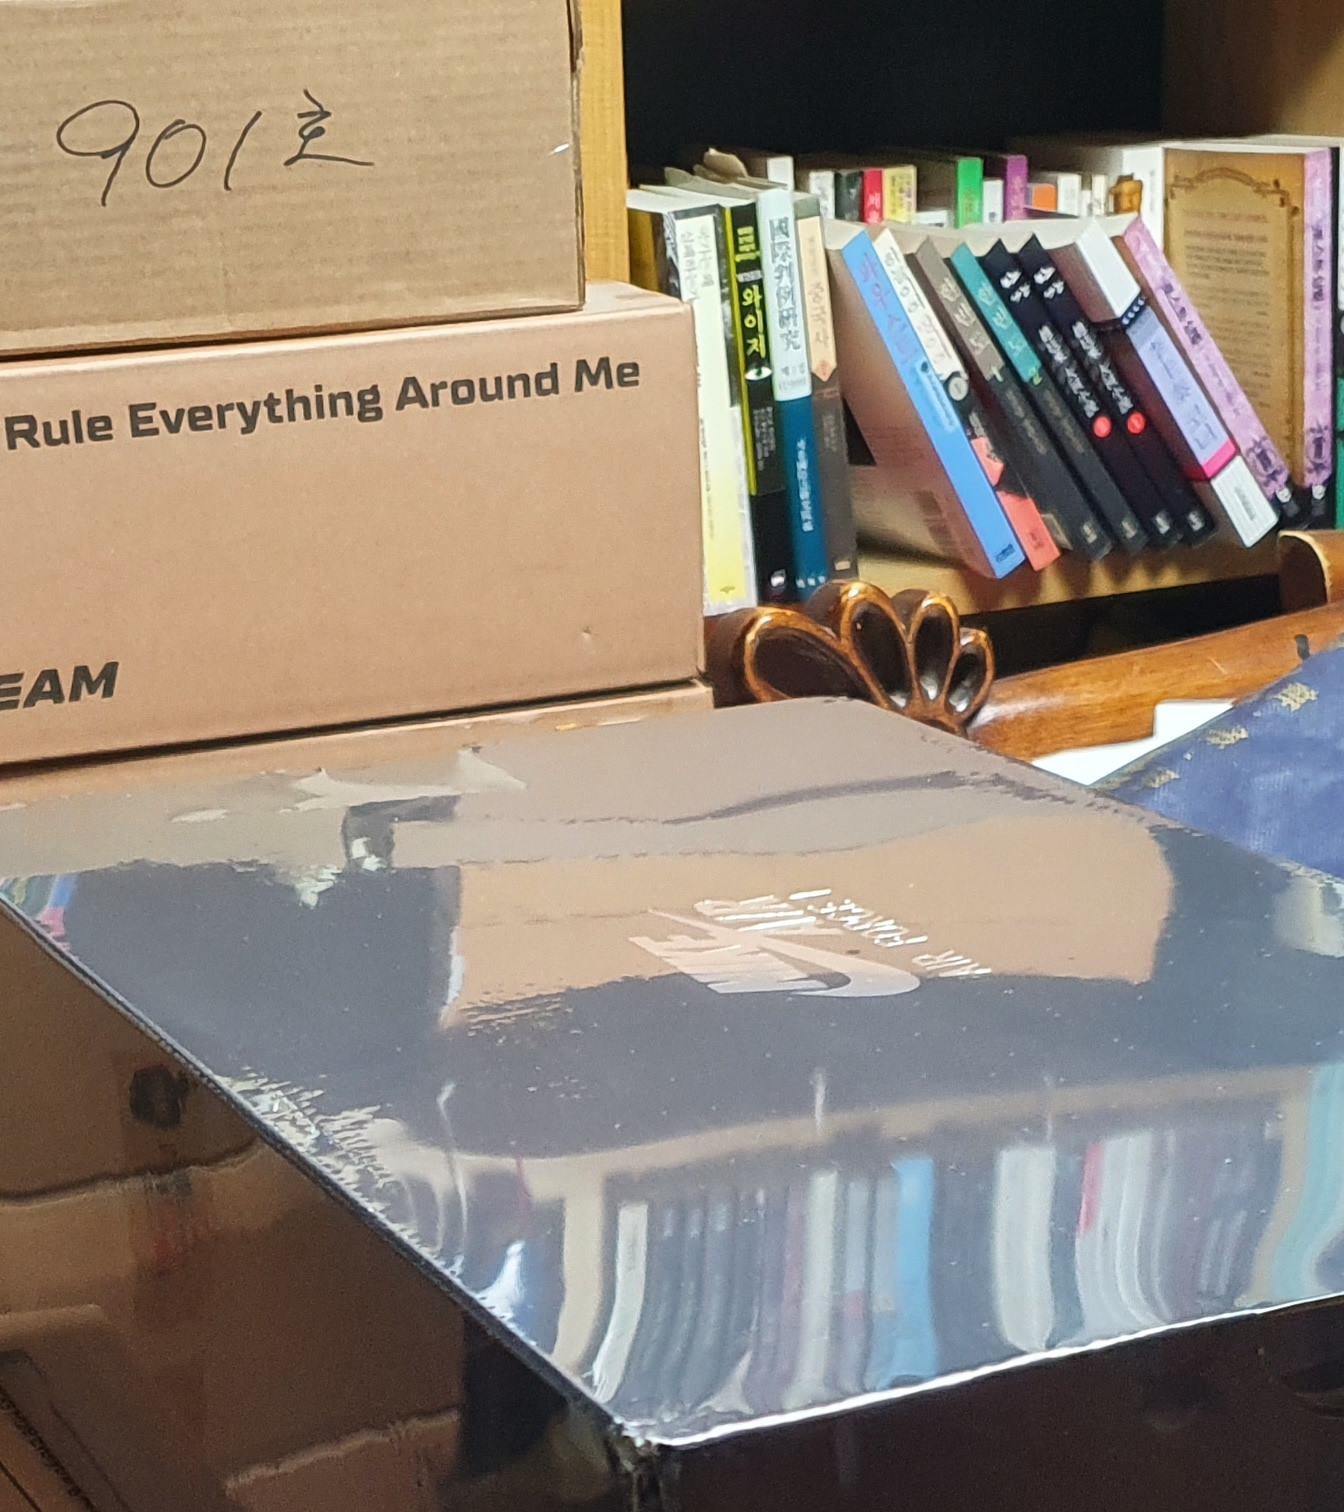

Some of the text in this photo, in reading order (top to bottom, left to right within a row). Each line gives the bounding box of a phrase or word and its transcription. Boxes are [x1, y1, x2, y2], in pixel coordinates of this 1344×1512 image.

[4, 408, 115, 453] Rule
[129, 382, 385, 440] Everything
[395, 360, 560, 411] Around
[573, 356, 642, 393] Me
